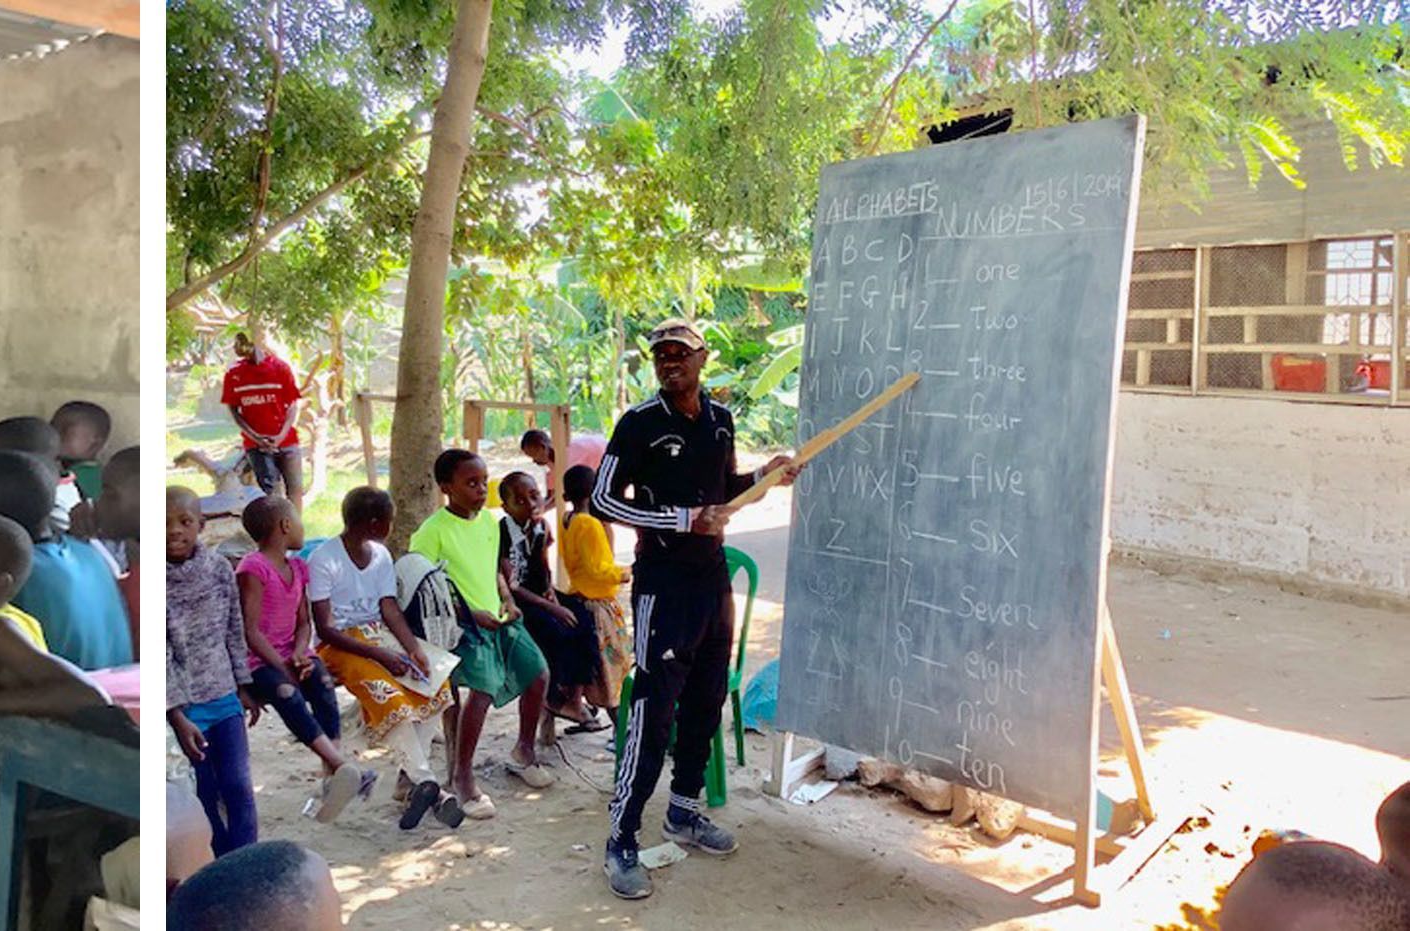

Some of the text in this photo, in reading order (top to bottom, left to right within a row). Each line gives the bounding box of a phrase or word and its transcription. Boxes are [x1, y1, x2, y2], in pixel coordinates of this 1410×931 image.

[825, 180, 939, 222] ALPHABETS
[936, 202, 1086, 237] NUMBERS
[898, 232, 913, 263] D
[976, 262, 1021, 282] one
[964, 392, 1022, 432] four
[965, 452, 1026, 499] five
